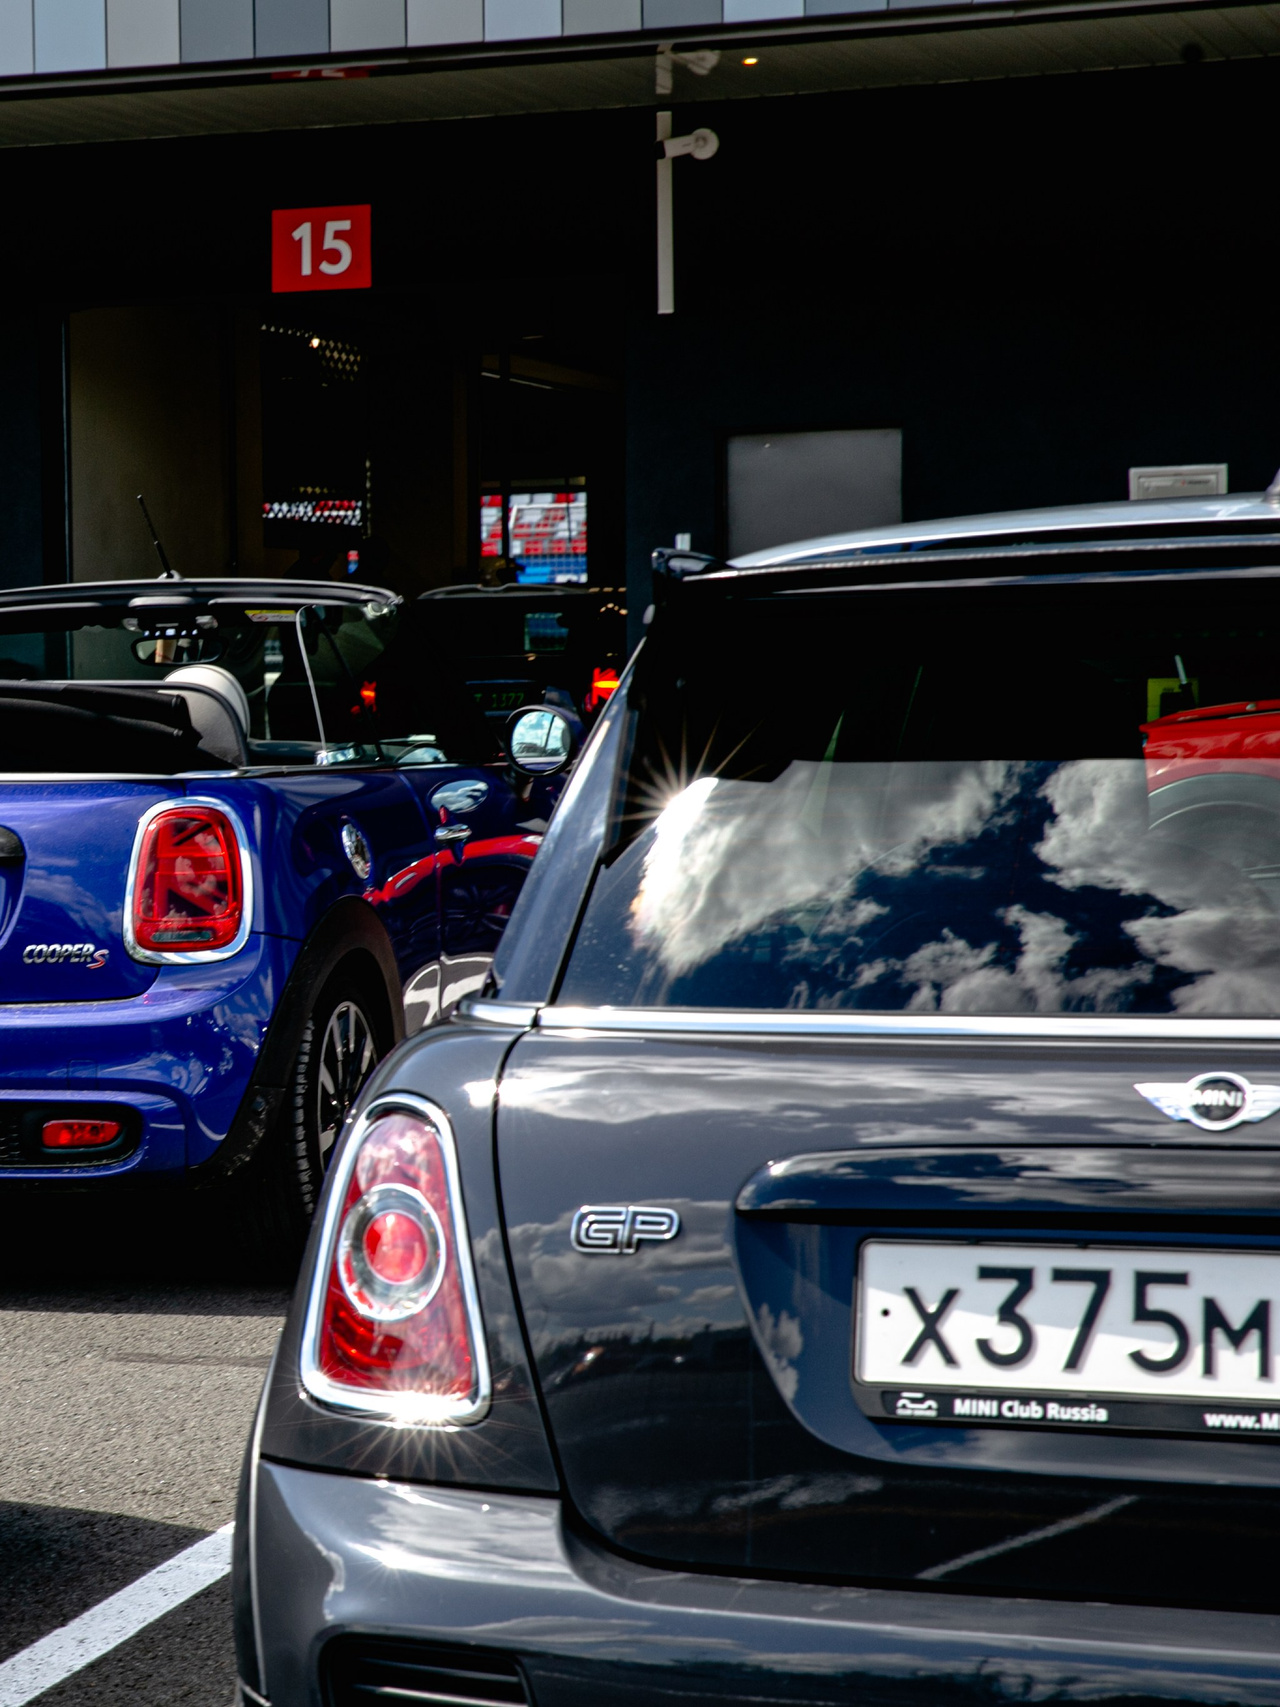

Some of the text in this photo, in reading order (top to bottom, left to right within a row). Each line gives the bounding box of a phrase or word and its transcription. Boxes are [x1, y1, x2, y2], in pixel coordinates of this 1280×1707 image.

[291, 219, 352, 276] 15
[22, 943, 109, 969] COOPER S
[1192, 1089, 1243, 1107] MINI
[570, 1205, 680, 1254] GP
[953, 1398, 998, 1417] MINI
[1001, 1400, 1044, 1419] Club
[1046, 1403, 1108, 1422] Russia
